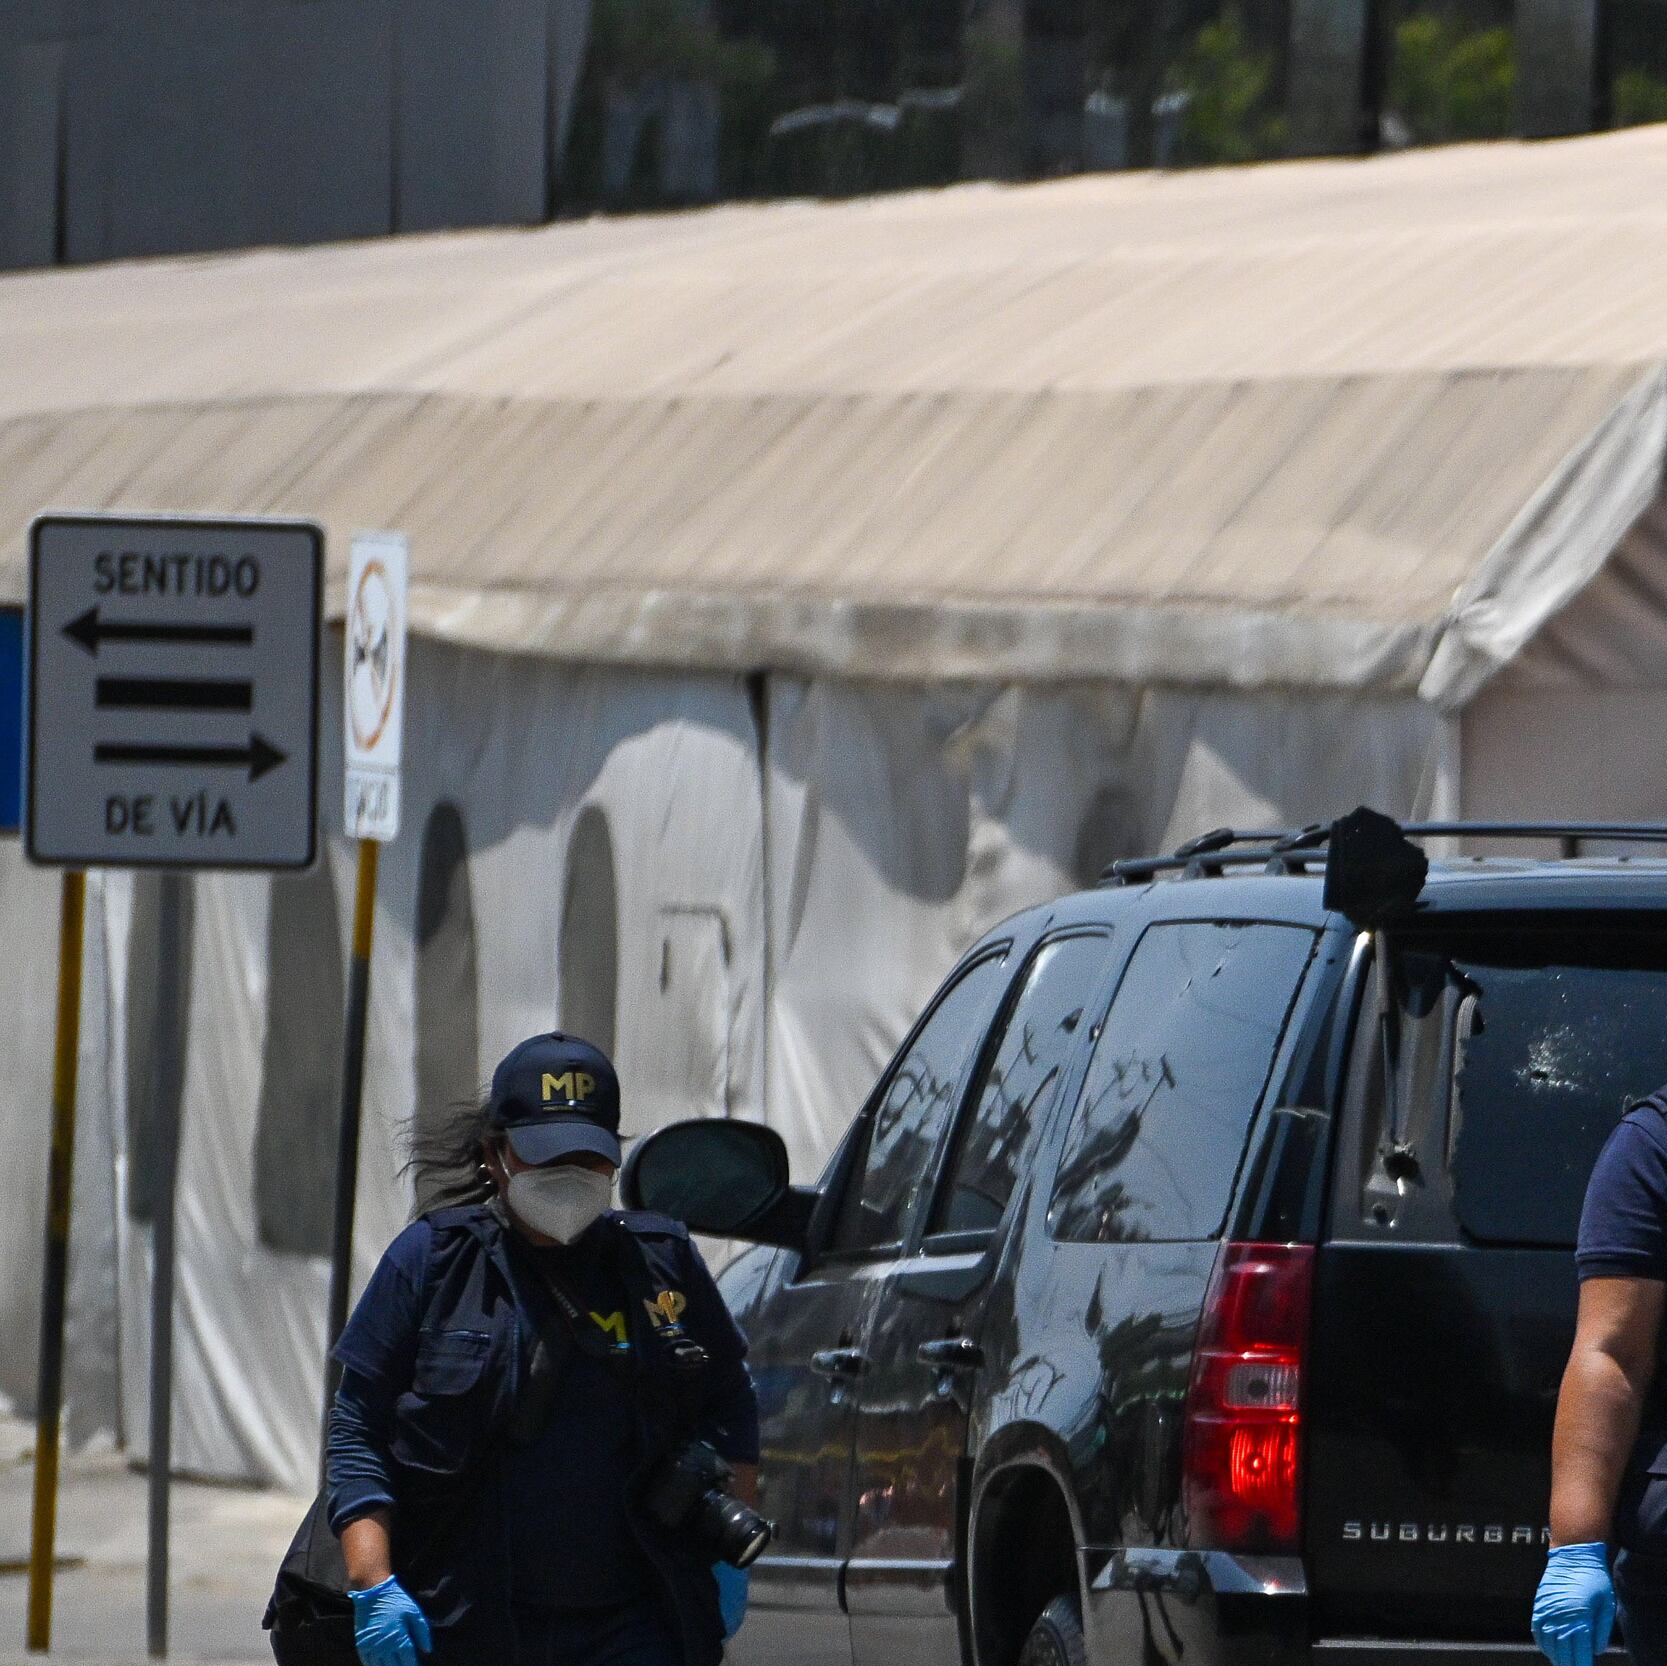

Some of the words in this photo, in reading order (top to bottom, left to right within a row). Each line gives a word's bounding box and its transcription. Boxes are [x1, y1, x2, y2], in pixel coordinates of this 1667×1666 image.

[94, 552, 260, 596] SENTIDO
[104, 794, 153, 836] DE
[541, 1072, 596, 1100] MP
[589, 1311, 628, 1343] M
